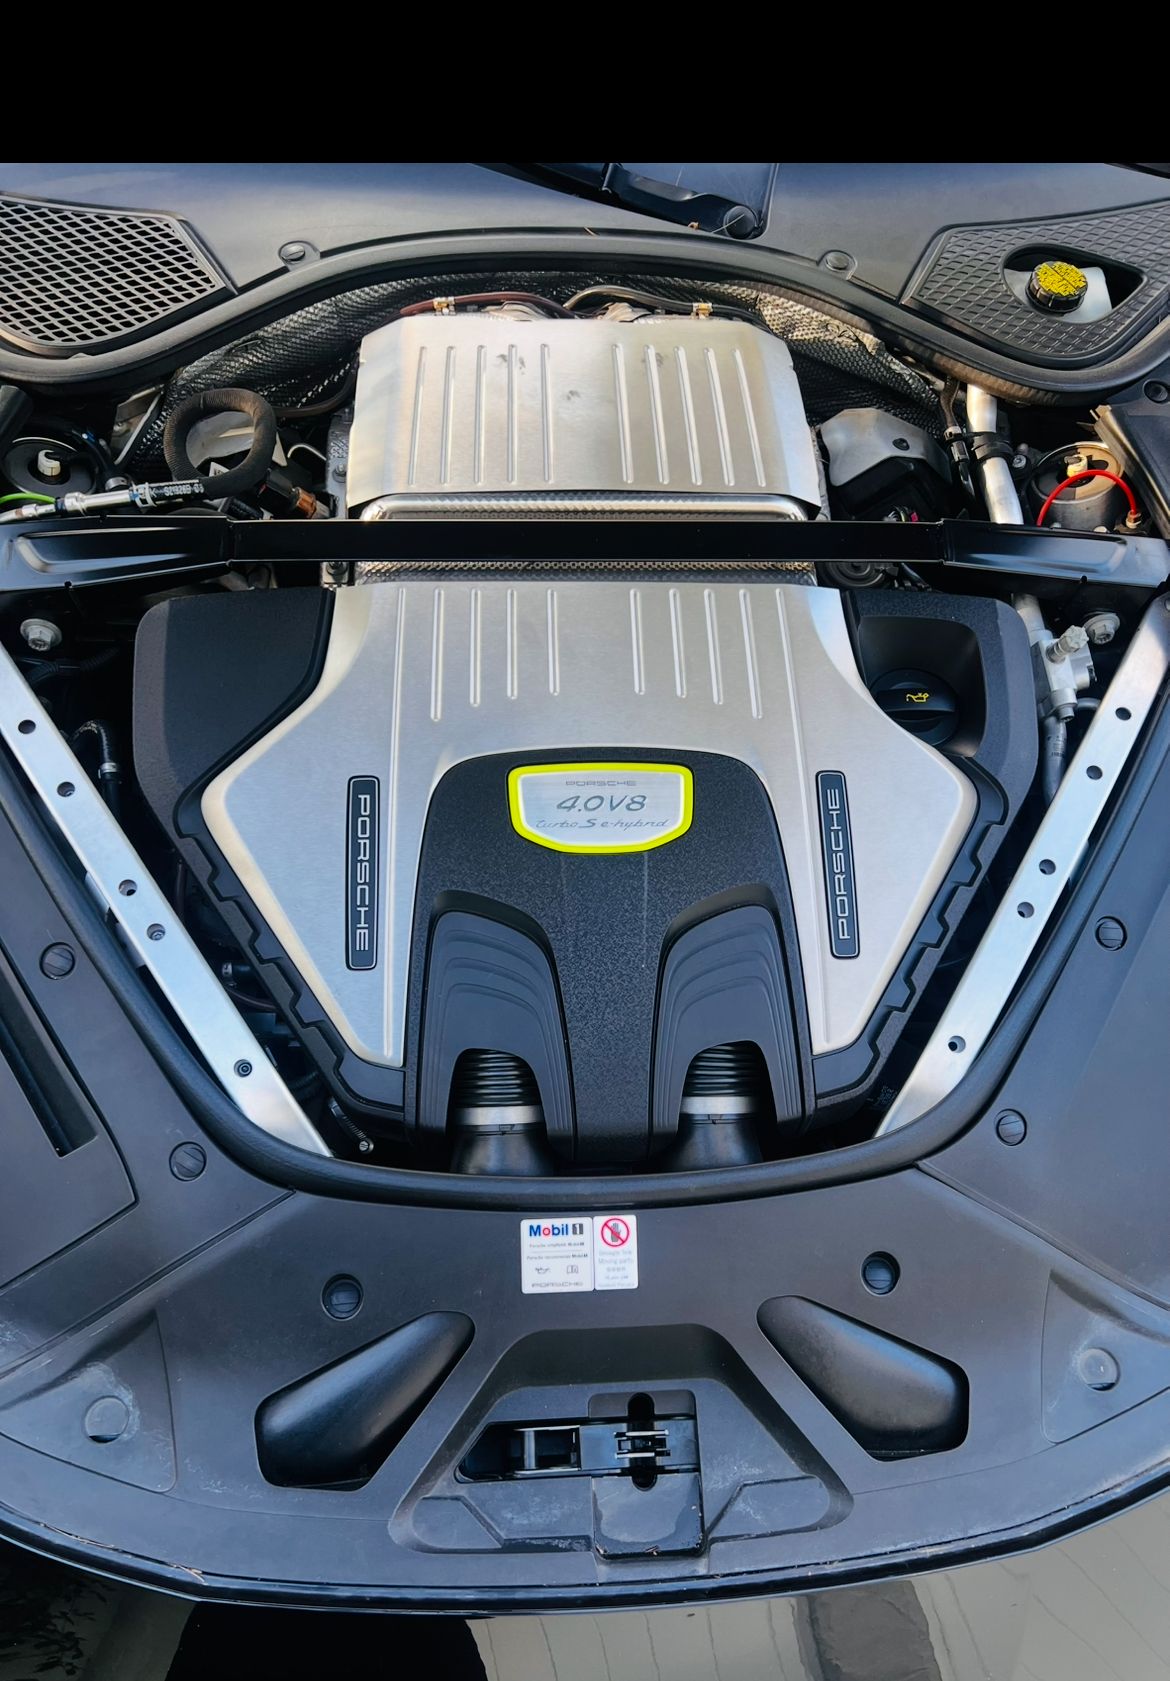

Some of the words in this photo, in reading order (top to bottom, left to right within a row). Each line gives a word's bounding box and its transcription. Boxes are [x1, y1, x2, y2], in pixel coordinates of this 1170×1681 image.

[355, 794, 371, 952] PORSCHE
[827, 788, 851, 940] PORSCHE
[529, 1223, 569, 1237] Mobil
[572, 1223, 584, 1235] 1
